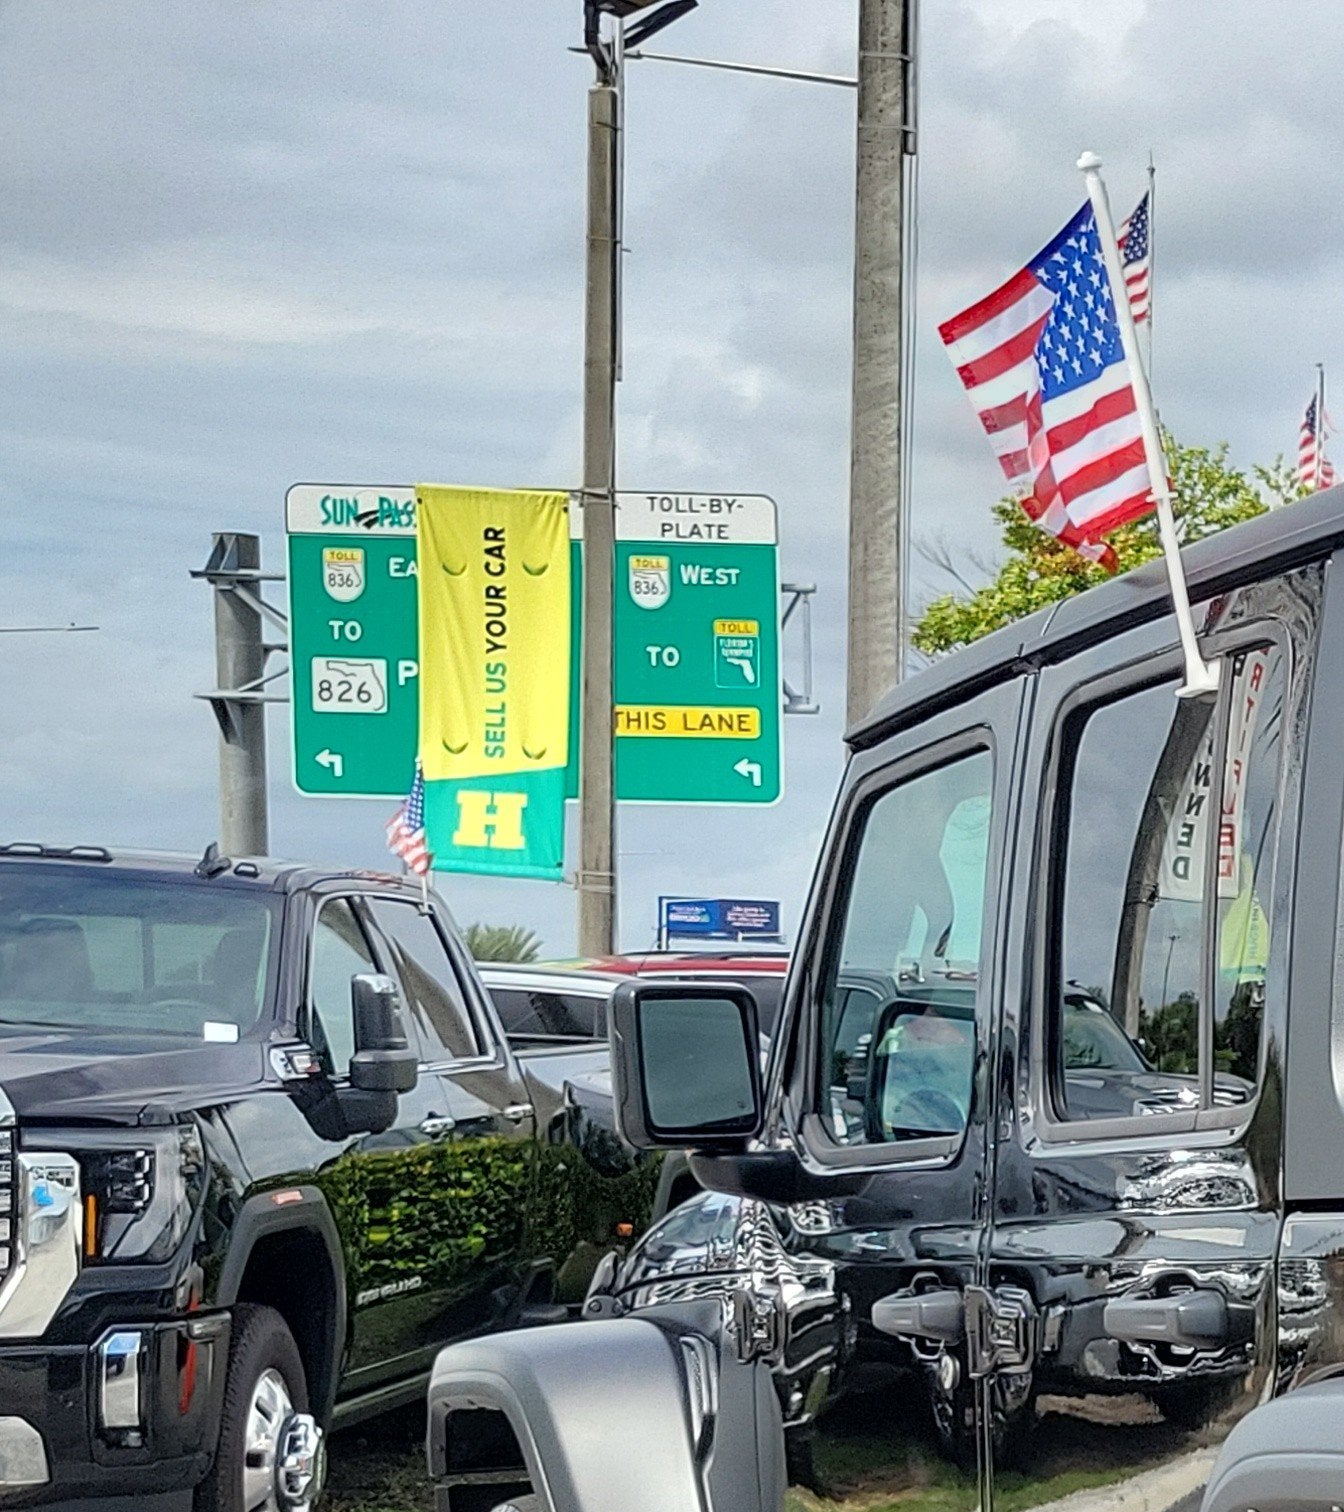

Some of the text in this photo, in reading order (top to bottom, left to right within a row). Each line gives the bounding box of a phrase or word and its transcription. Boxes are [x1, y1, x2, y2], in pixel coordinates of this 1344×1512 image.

[378, 496, 418, 529] PAS
[647, 496, 744, 514] TOLL-BY-
[661, 523, 729, 539] PLATE
[330, 551, 357, 560] TOLL
[635, 558, 662, 568] TOLL
[328, 573, 354, 588] 836
[680, 564, 741, 585] WEST
[634, 581, 660, 595] 836
[328, 620, 362, 641] TO
[721, 623, 752, 634] TOLL
[483, 526, 507, 759] SELL US YOUR CAR
[646, 646, 680, 667] TO
[318, 679, 372, 703] 826
[613, 711, 752, 732] THIS LANE
[453, 789, 528, 851] H
